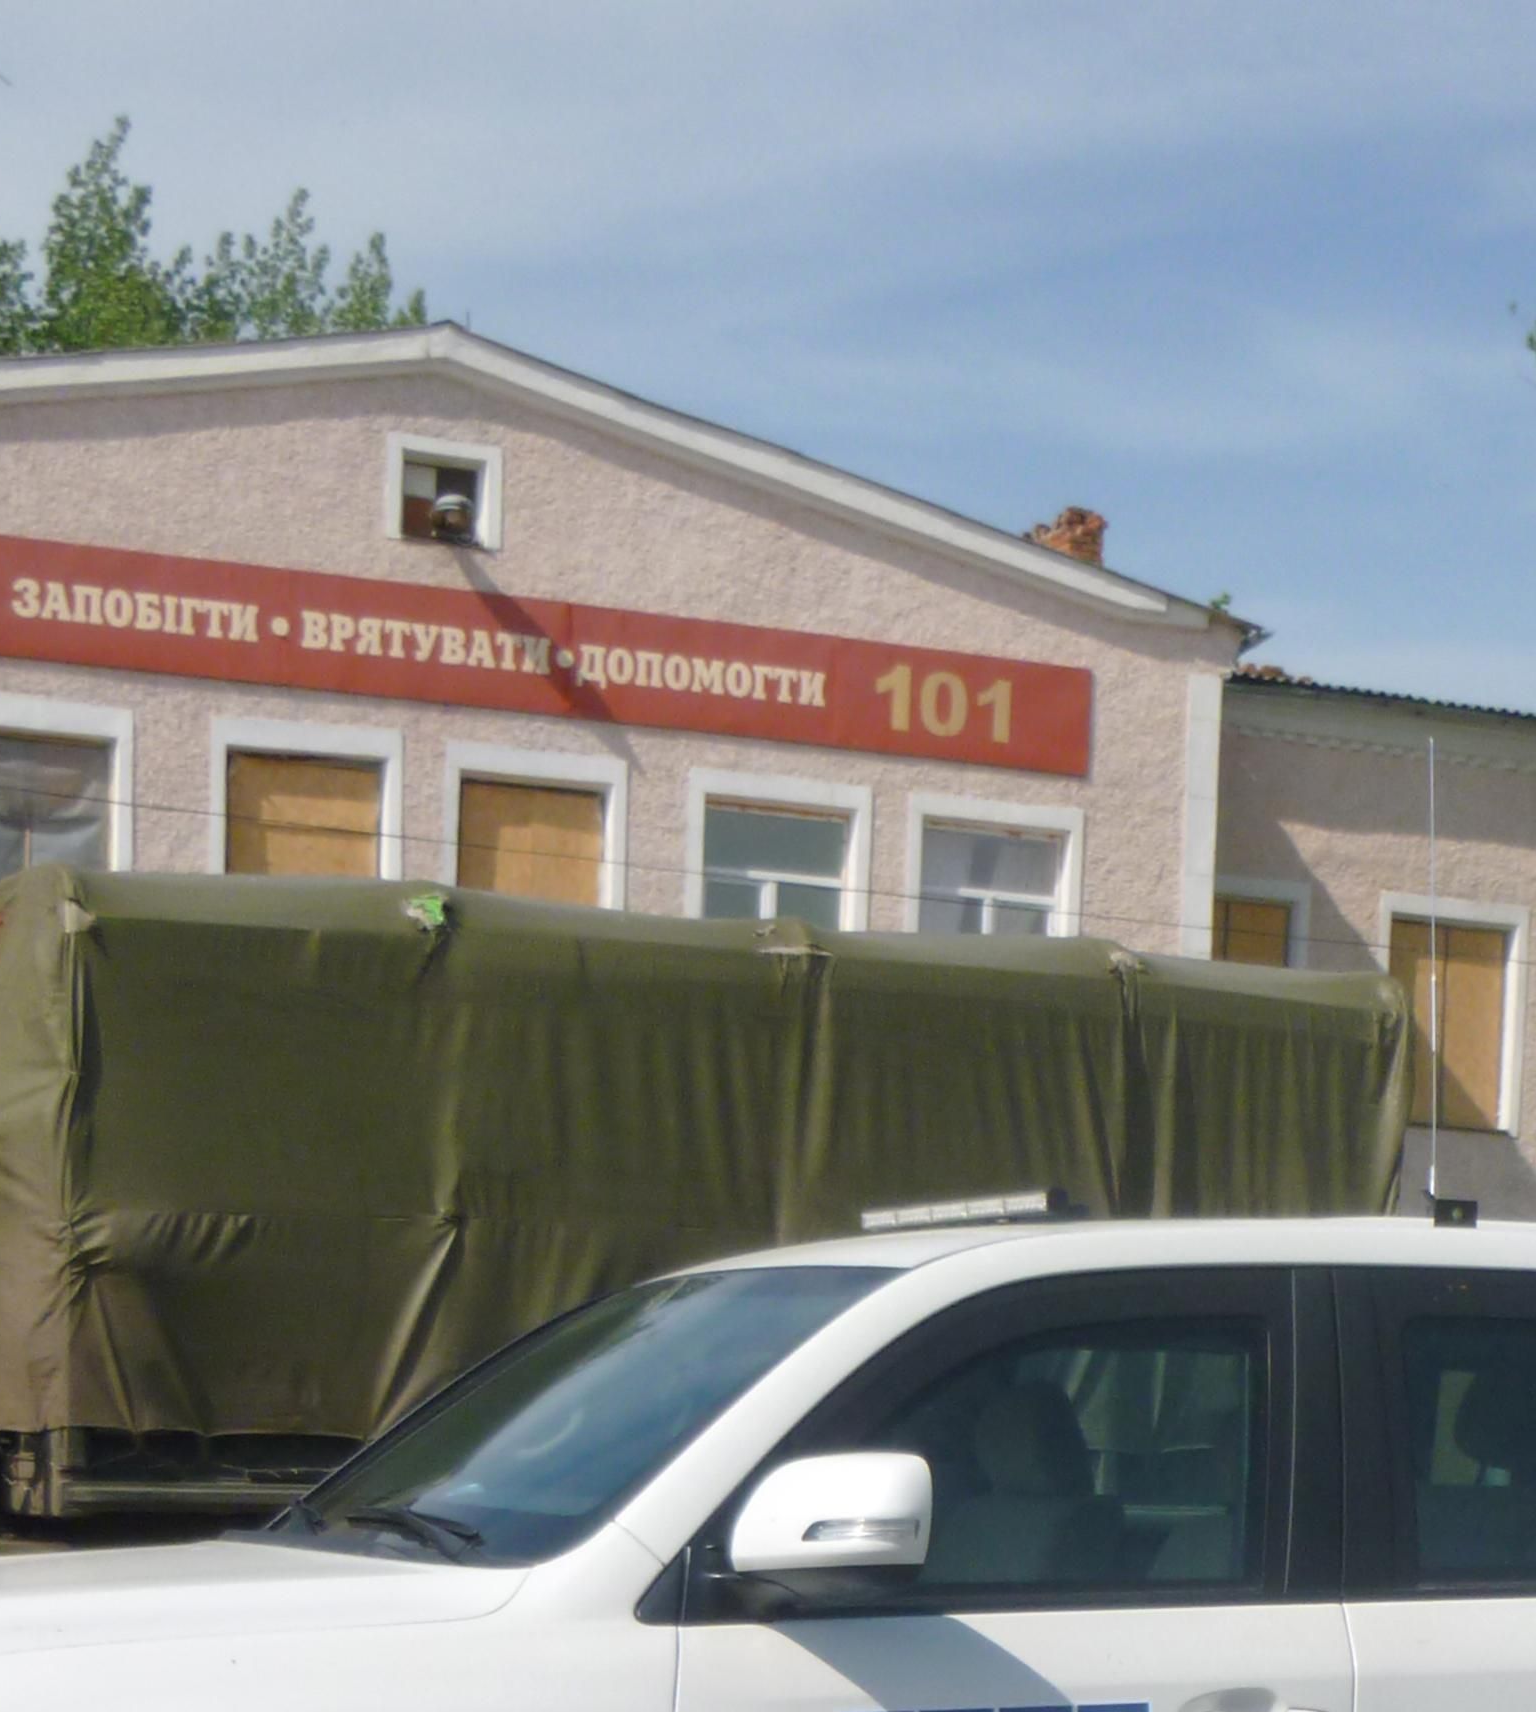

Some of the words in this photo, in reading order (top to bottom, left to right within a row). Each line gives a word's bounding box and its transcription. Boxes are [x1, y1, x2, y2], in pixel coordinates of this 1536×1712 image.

[11, 577, 260, 643] ЗАПОБІГТИ
[300, 609, 552, 676] ВРЯТУВАТИ
[575, 642, 827, 708] ДОПОМОГТИ
[874, 662, 1014, 744] 101
